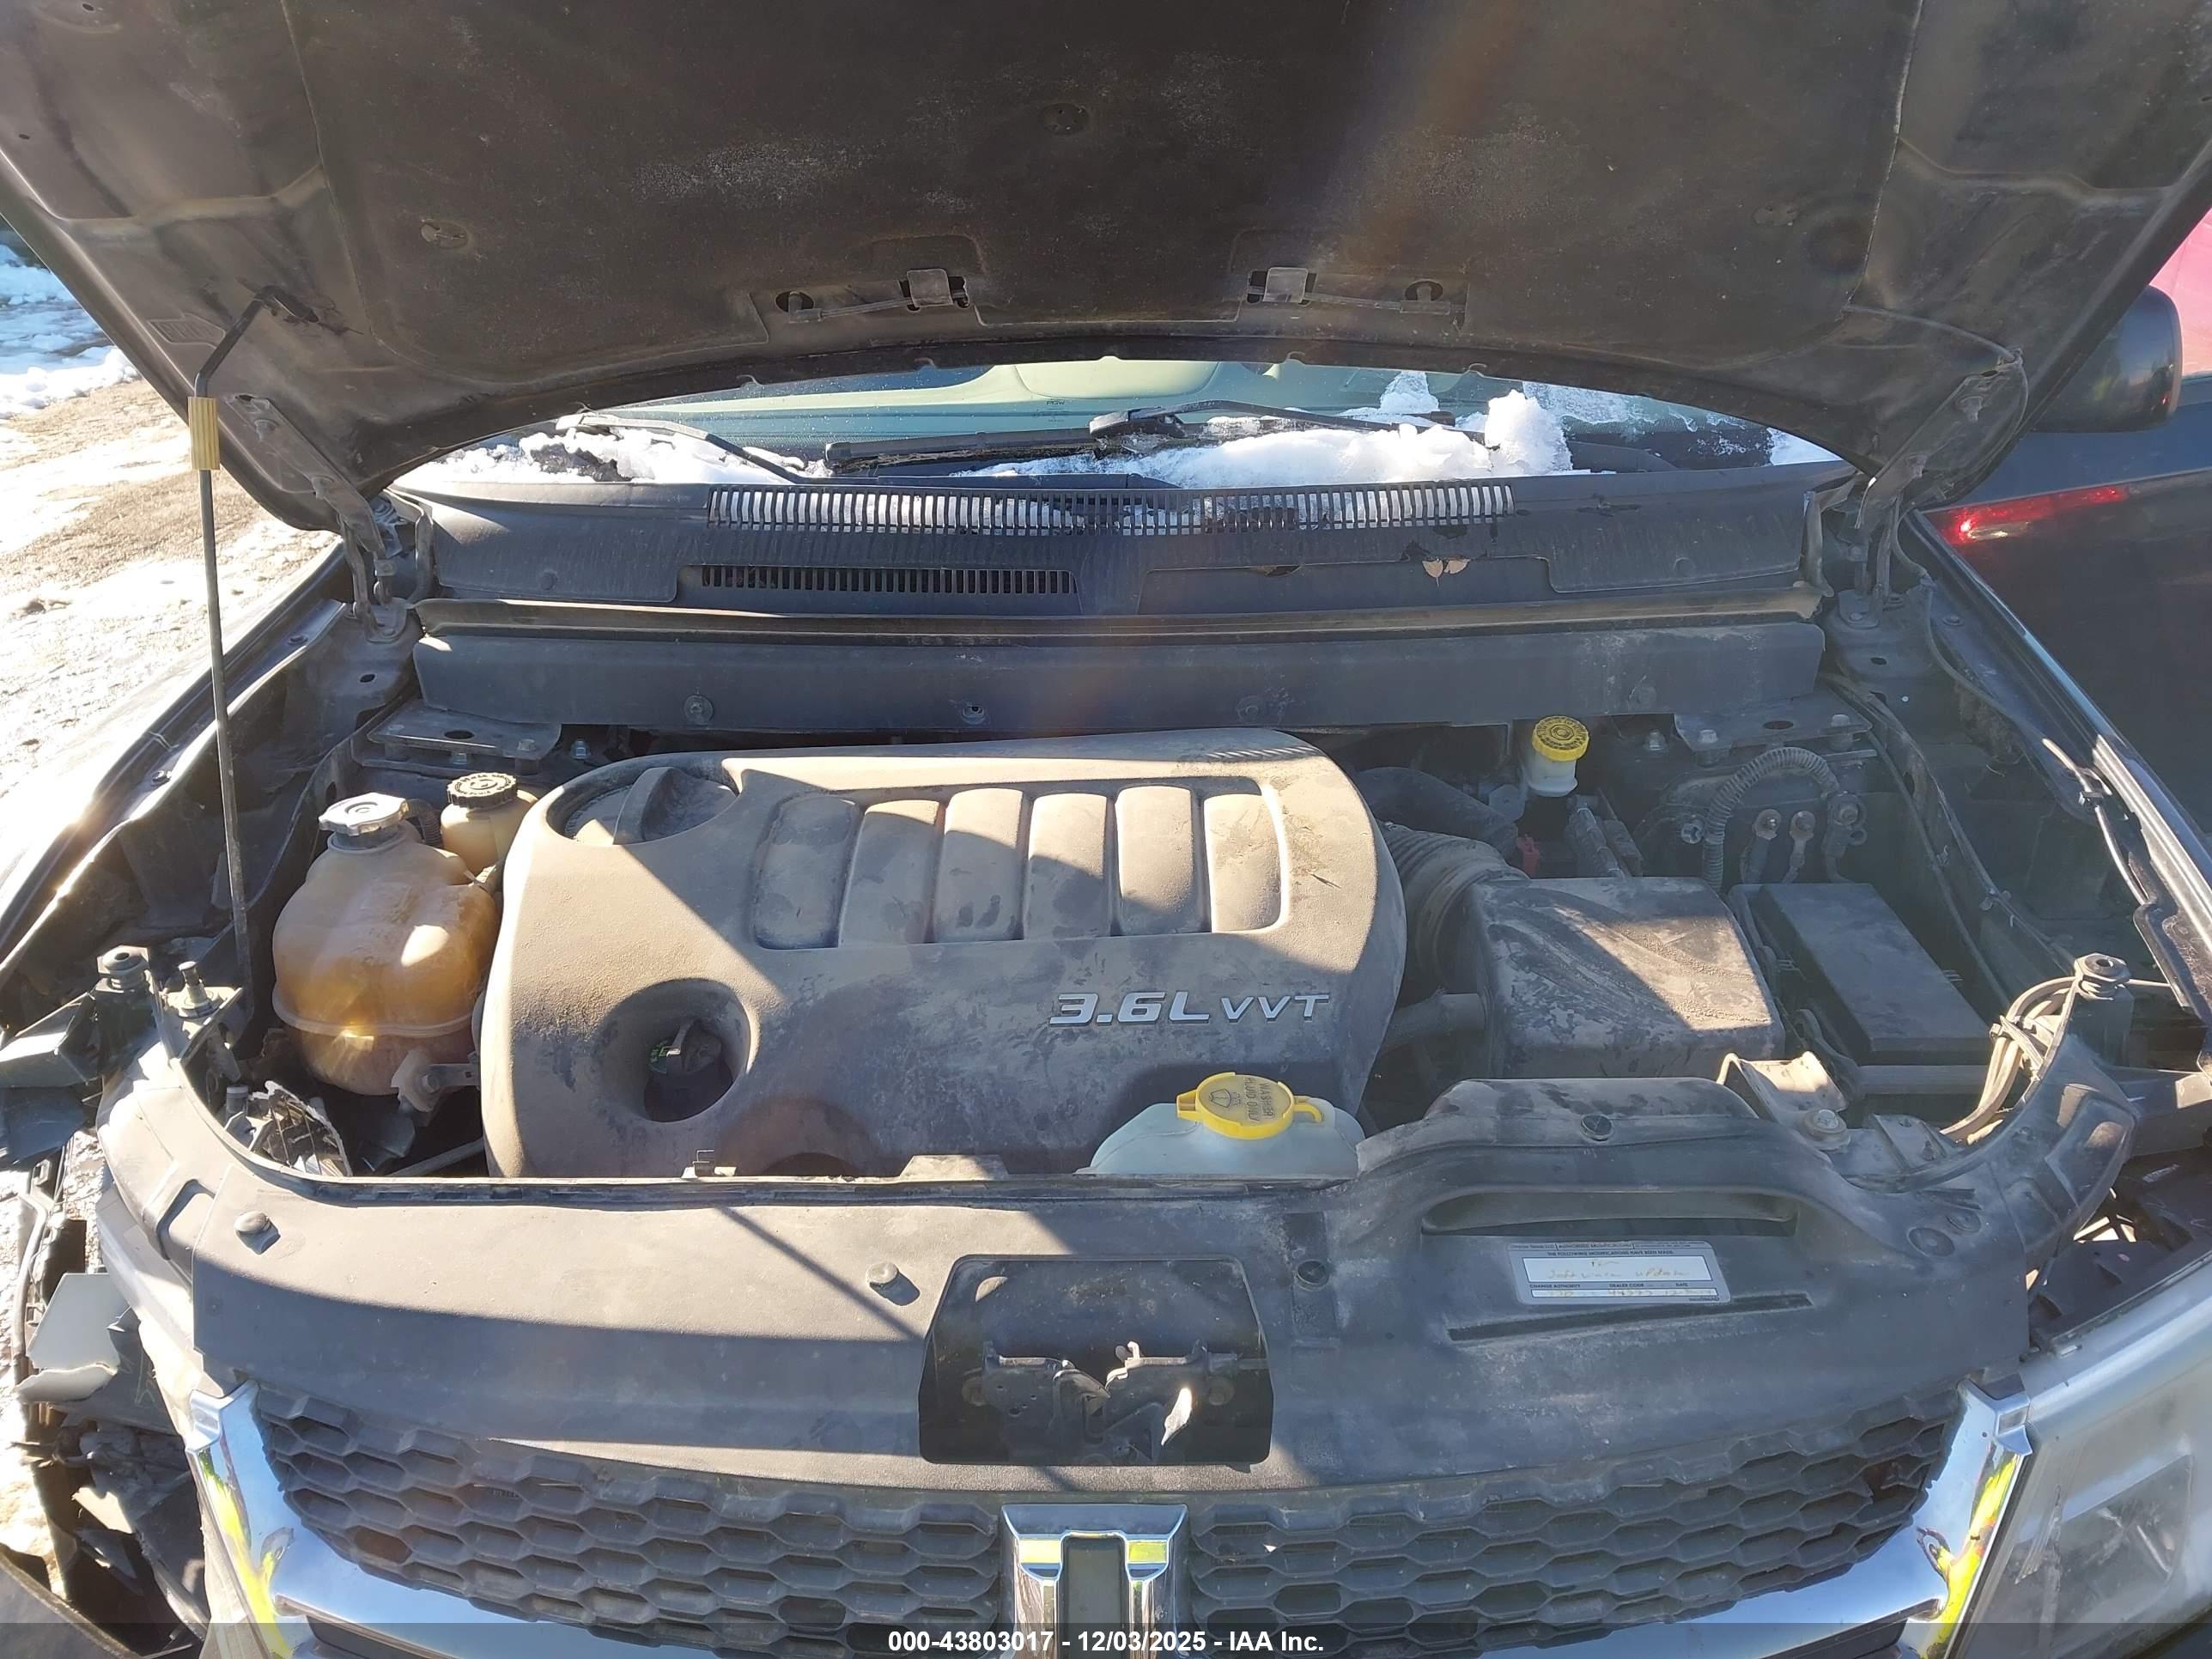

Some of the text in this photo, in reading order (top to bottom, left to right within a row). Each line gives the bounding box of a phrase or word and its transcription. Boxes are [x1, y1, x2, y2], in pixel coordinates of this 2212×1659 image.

[1048, 991, 1330, 1027] 3.6L VVT
[1243, 1077, 1260, 1121] FLUID ONLY
[1258, 1082, 1276, 1118] WASHER
